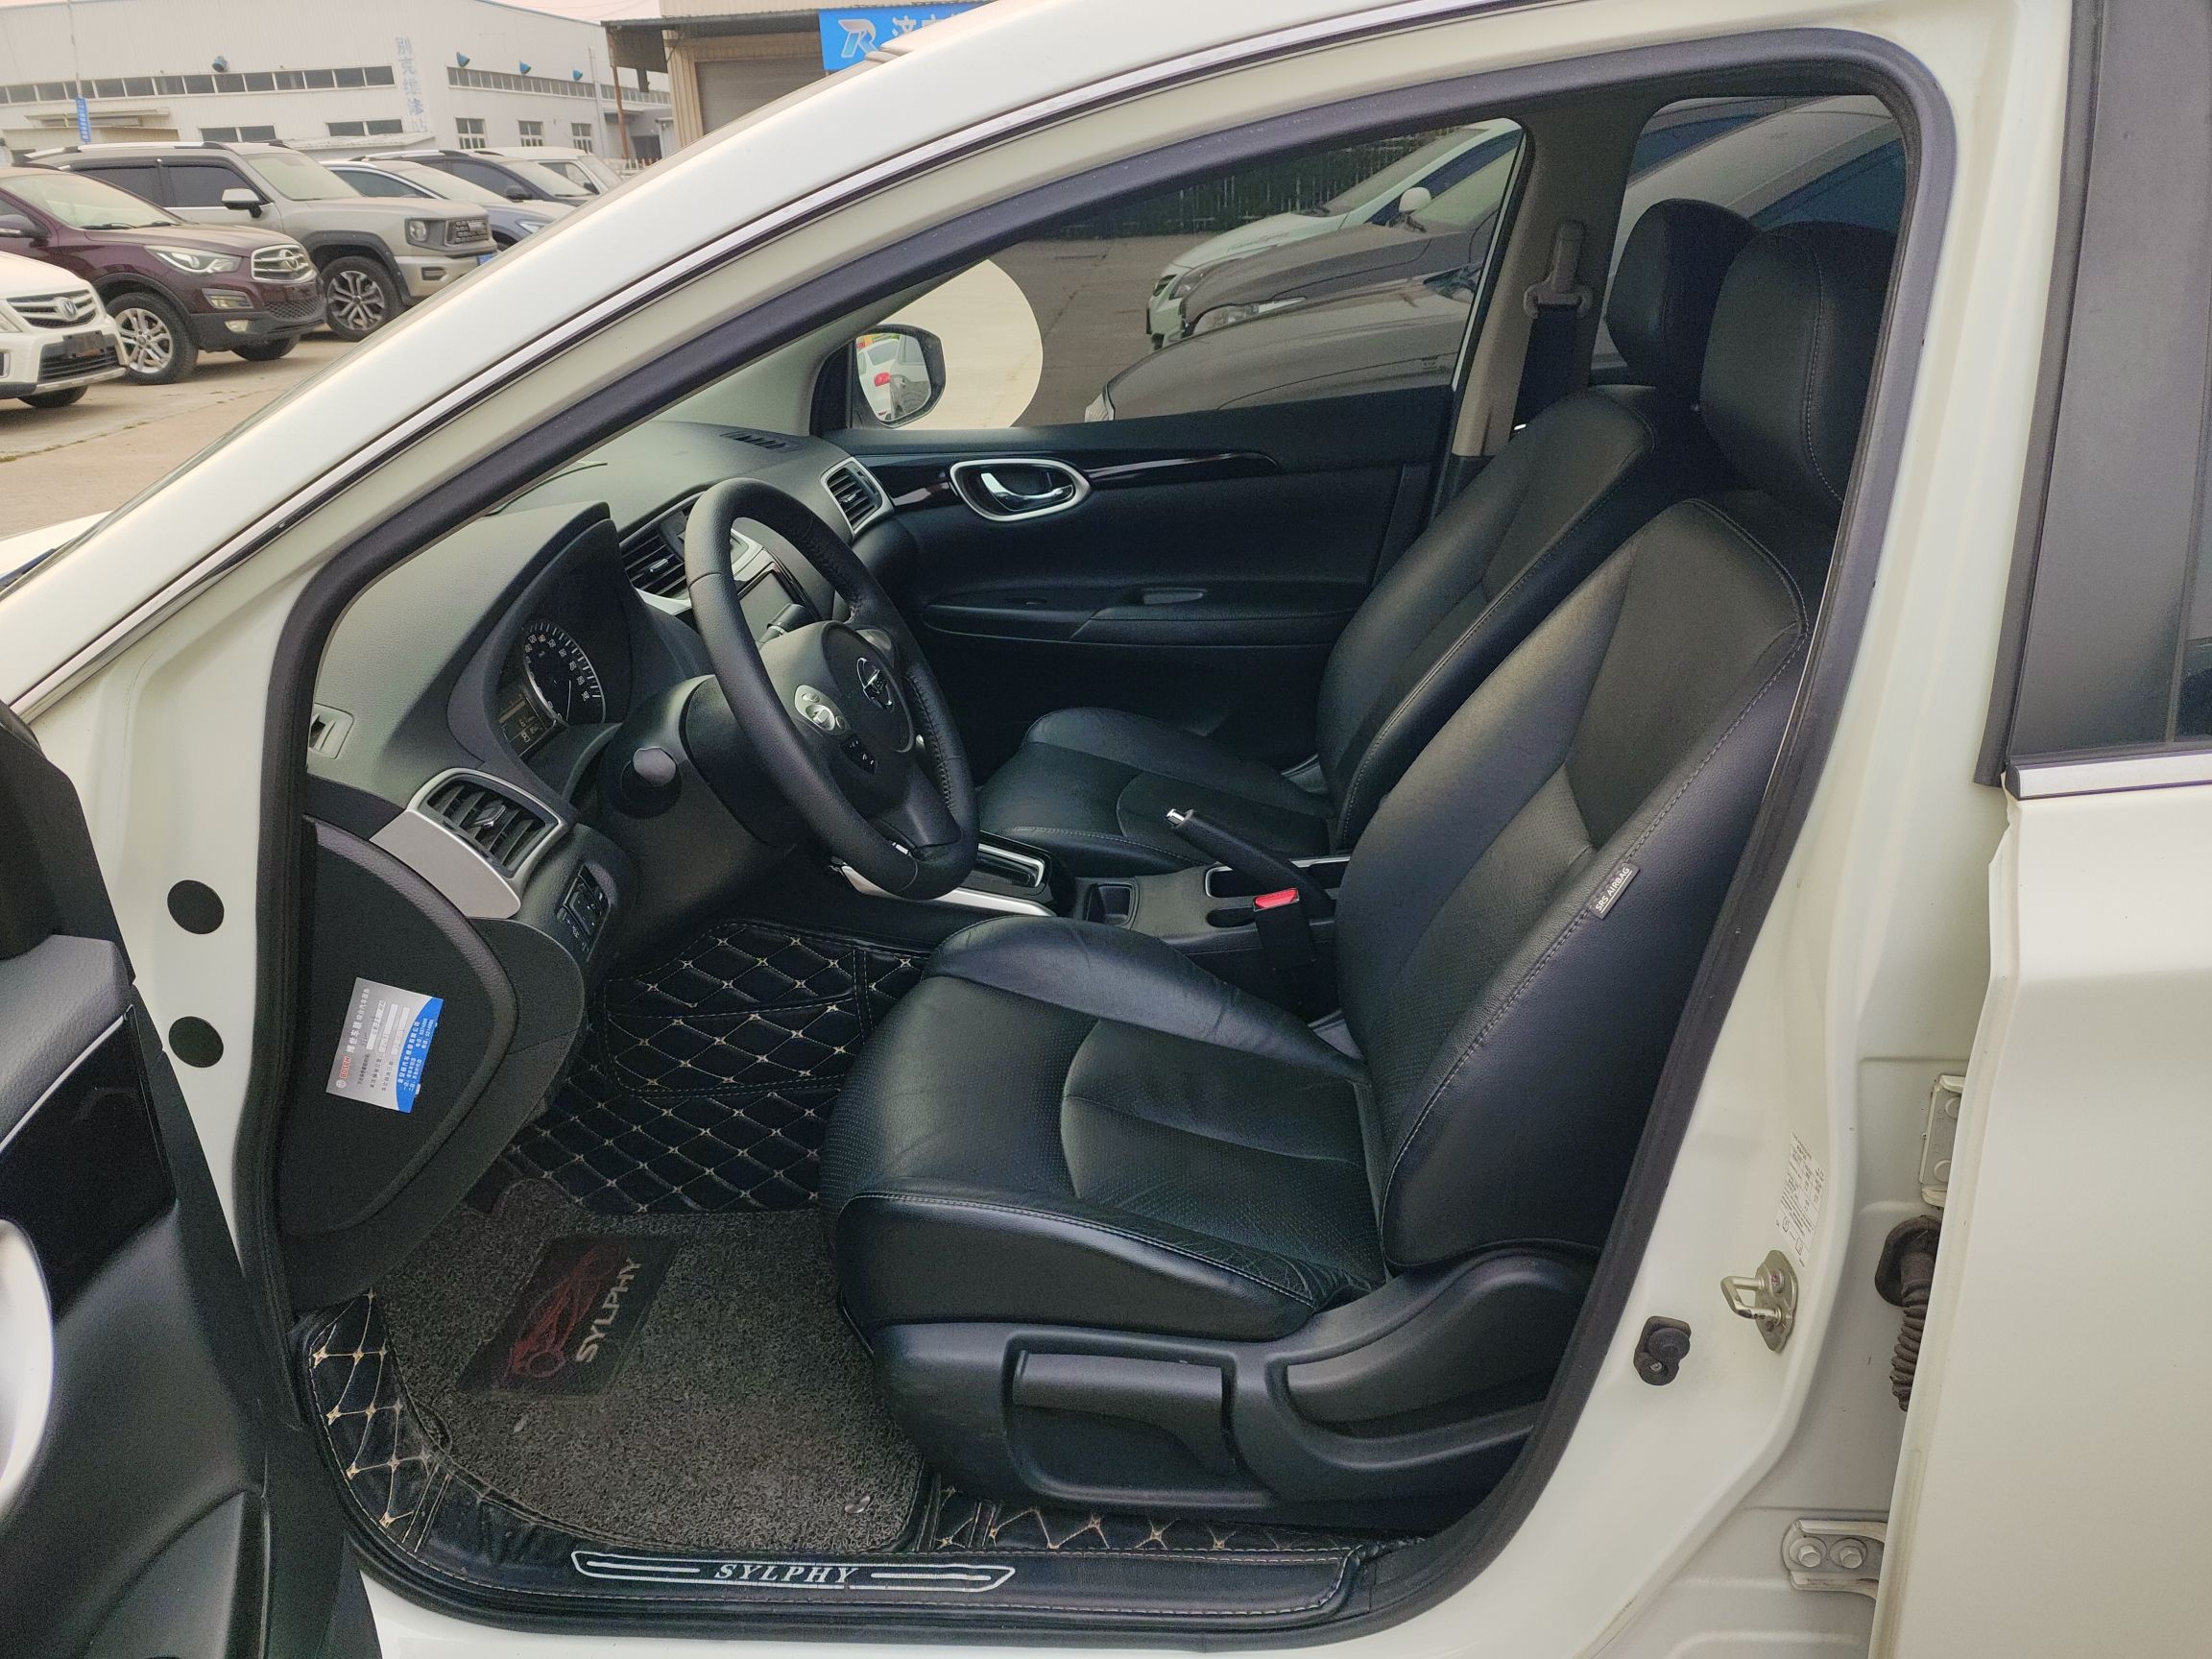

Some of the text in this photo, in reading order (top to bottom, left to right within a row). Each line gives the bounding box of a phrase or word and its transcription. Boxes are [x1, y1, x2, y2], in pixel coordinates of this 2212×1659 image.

[1595, 866, 1630, 912] SRS AIRBAG
[575, 1257, 642, 1363] SYLPHY
[714, 1563, 859, 1584] SYLPHY
